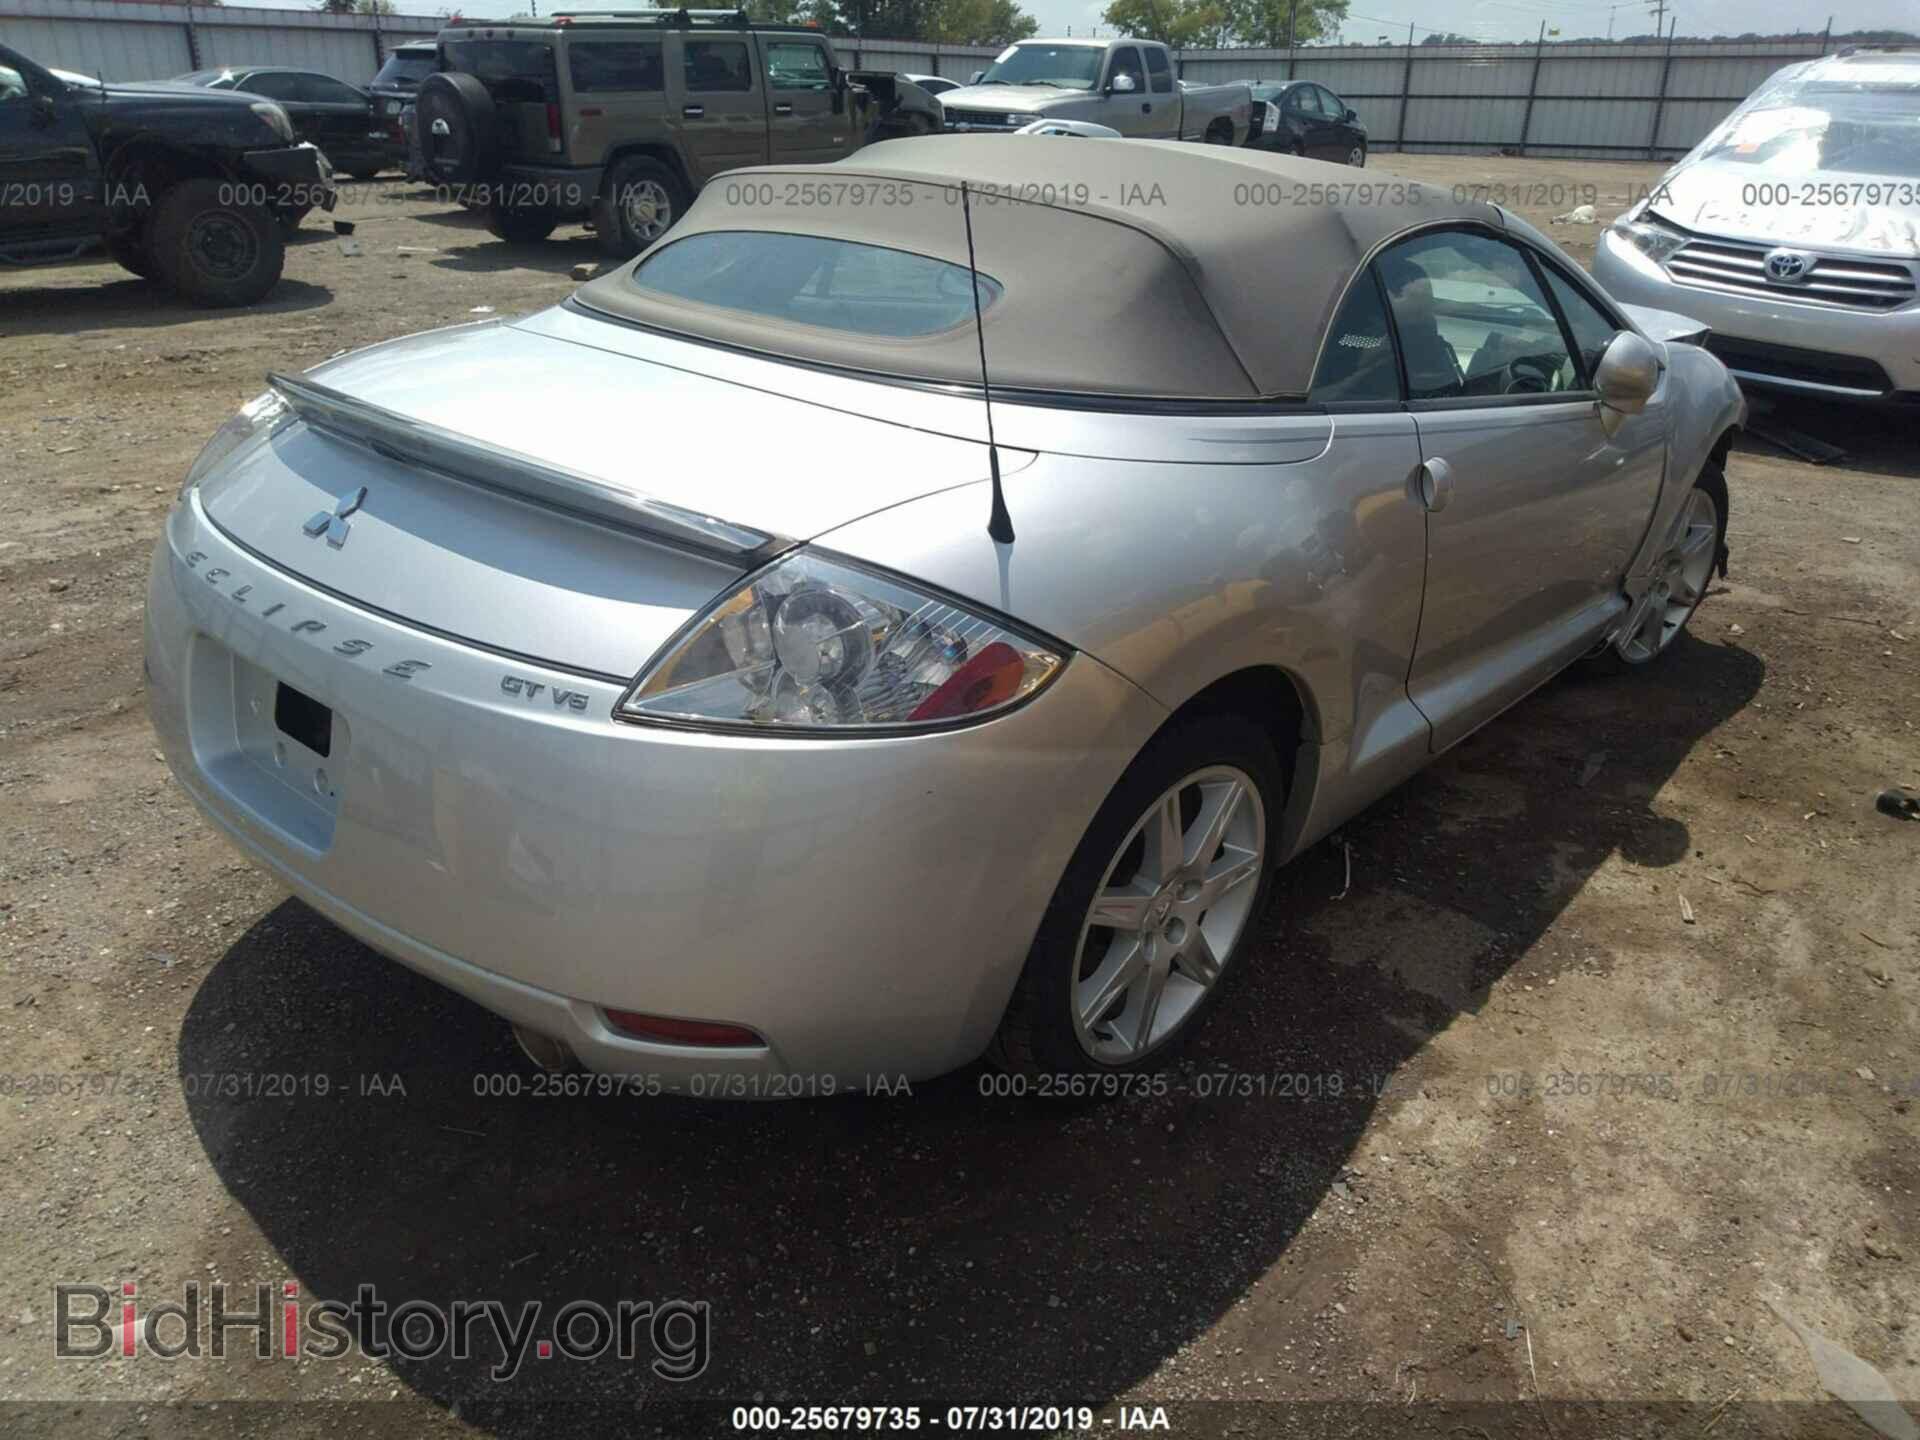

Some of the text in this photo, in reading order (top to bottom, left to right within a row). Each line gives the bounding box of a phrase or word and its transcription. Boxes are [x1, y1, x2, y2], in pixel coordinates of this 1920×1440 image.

[186, 551, 432, 679] ECLIPSE
[501, 676, 590, 711] GT V6
